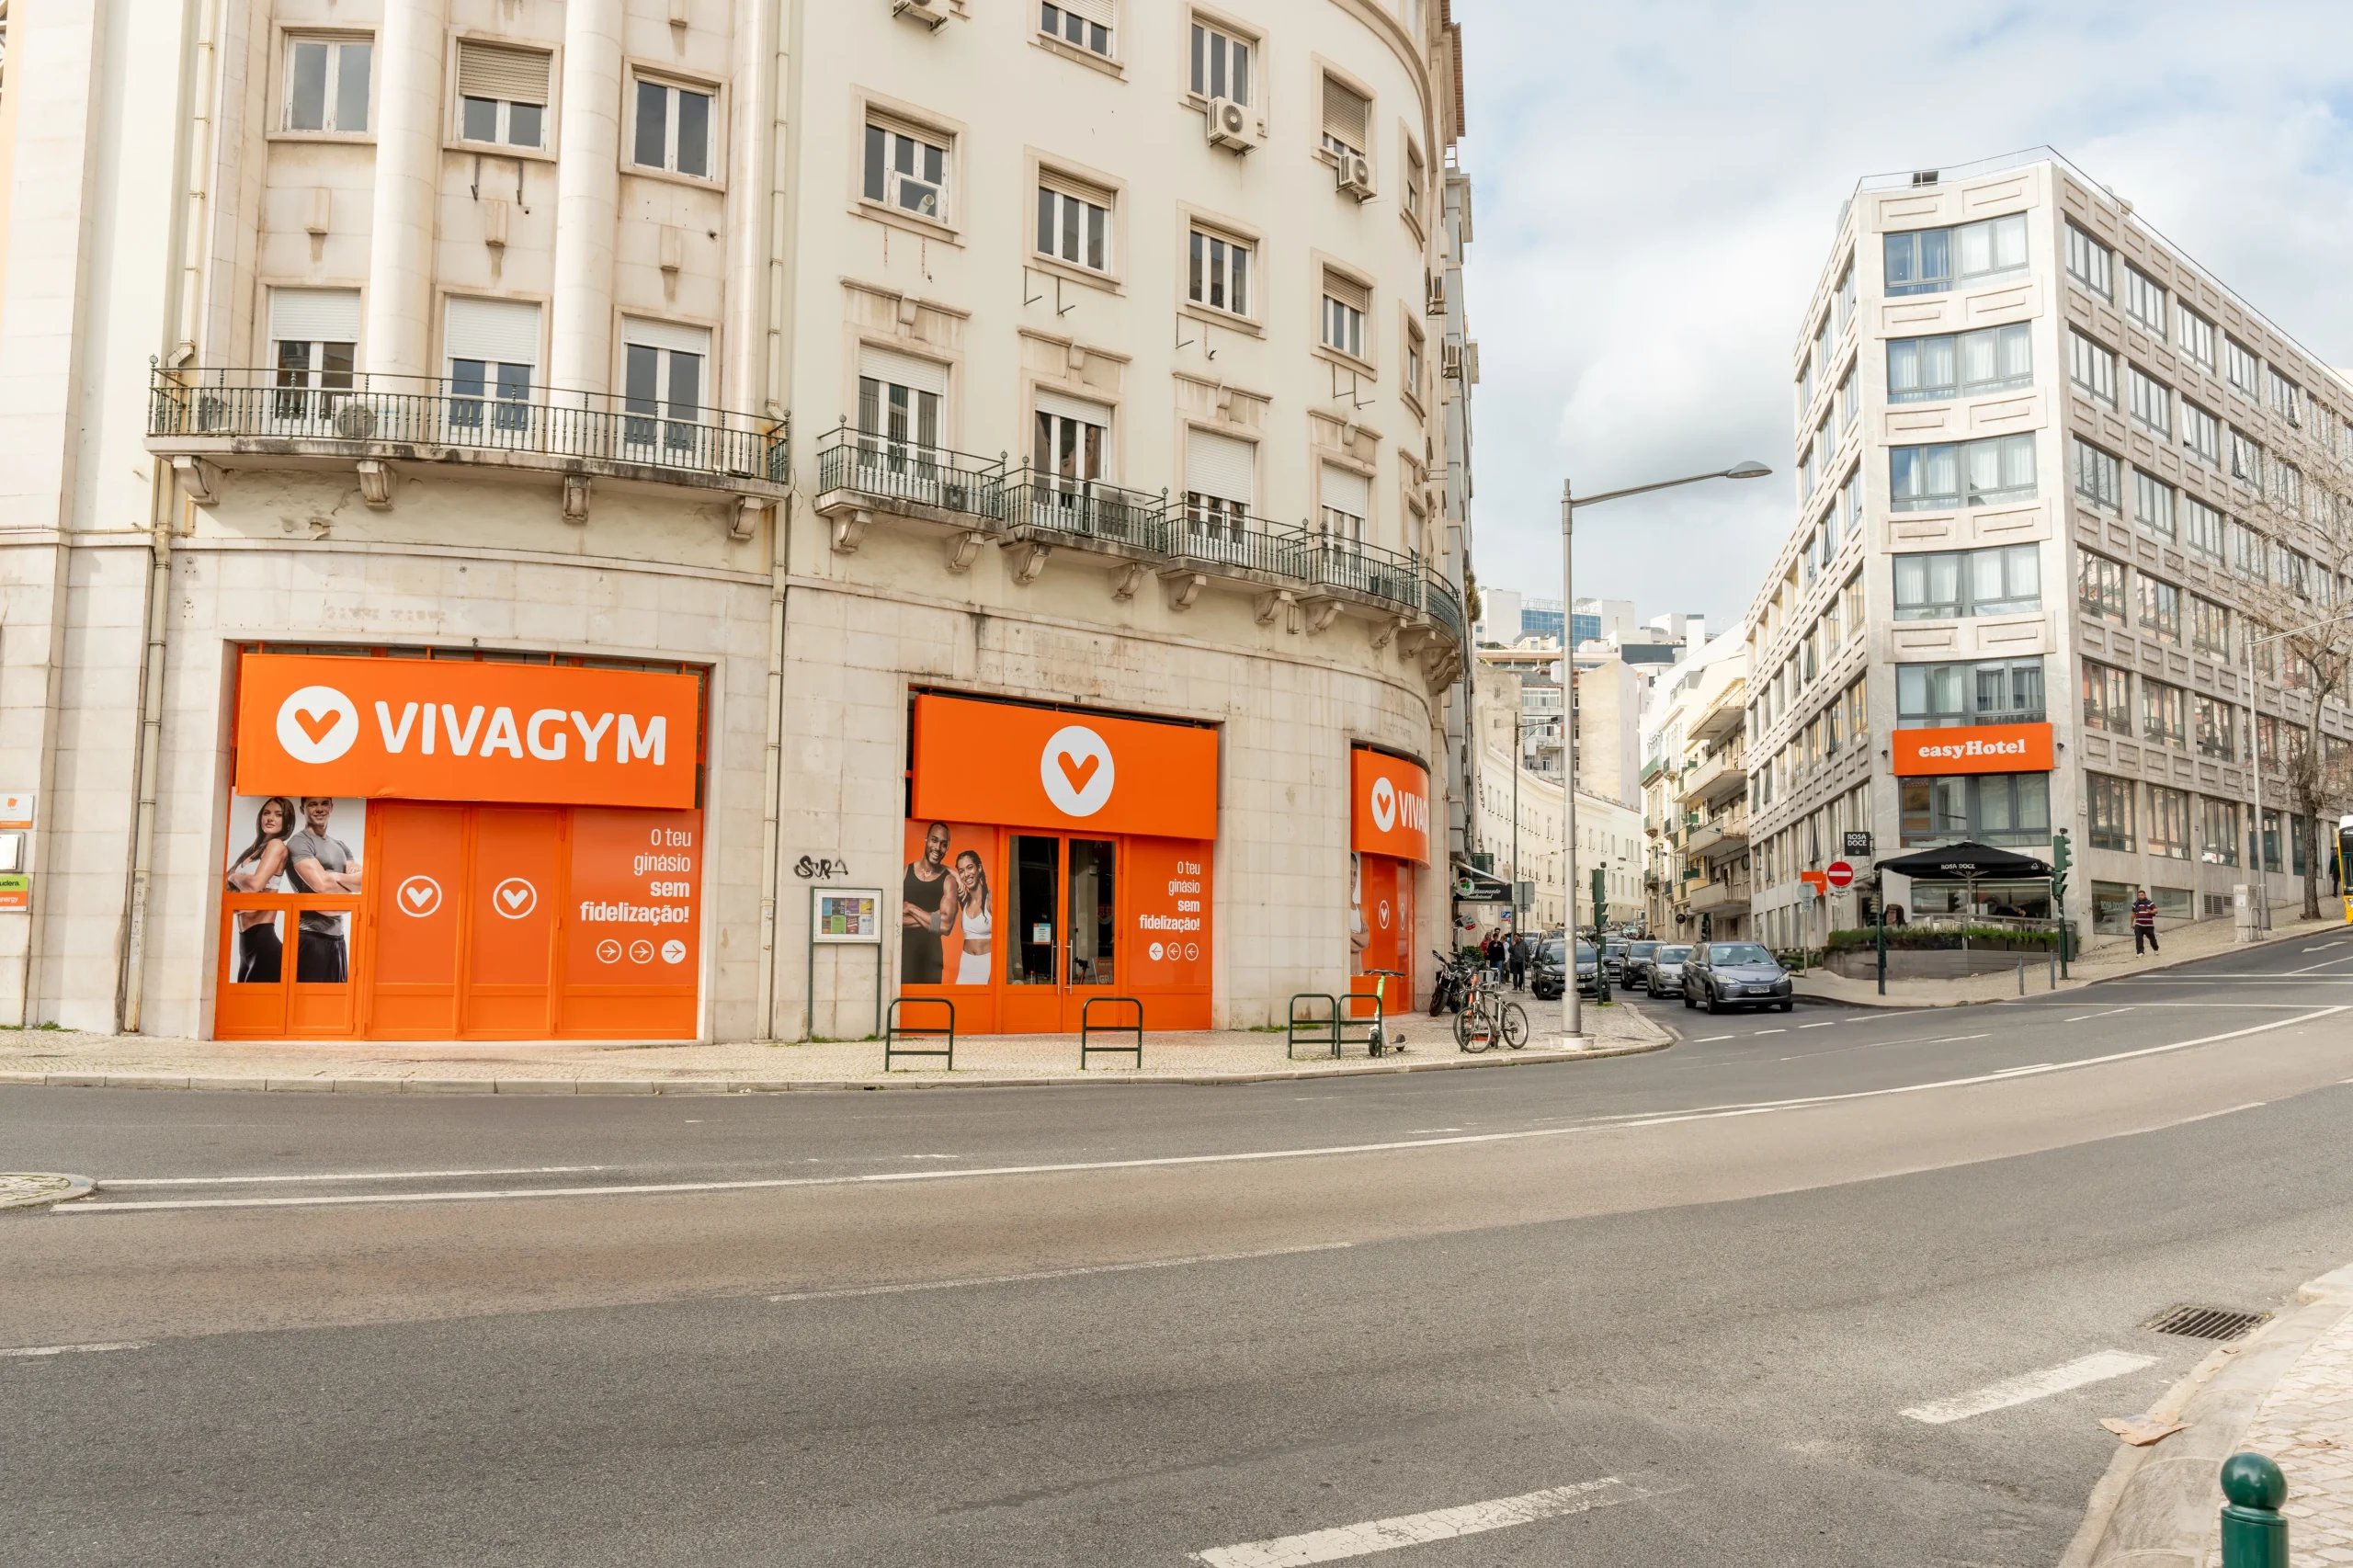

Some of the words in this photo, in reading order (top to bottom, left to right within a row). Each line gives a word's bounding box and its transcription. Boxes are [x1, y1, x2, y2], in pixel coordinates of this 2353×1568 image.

[375, 700, 666, 766] VIVAGYM
[1918, 739, 2026, 759] easyHotel
[651, 828, 661, 846] O
[665, 828, 691, 846] teu
[634, 853, 690, 876] ginásio
[1177, 861, 1183, 874] O
[1186, 861, 1200, 875] teu
[650, 881, 689, 898] sem
[1168, 879, 1199, 896] ginásio
[580, 901, 689, 926] fidelização!
[1178, 900, 1199, 912] sem
[1139, 915, 1199, 933] fidelização!
